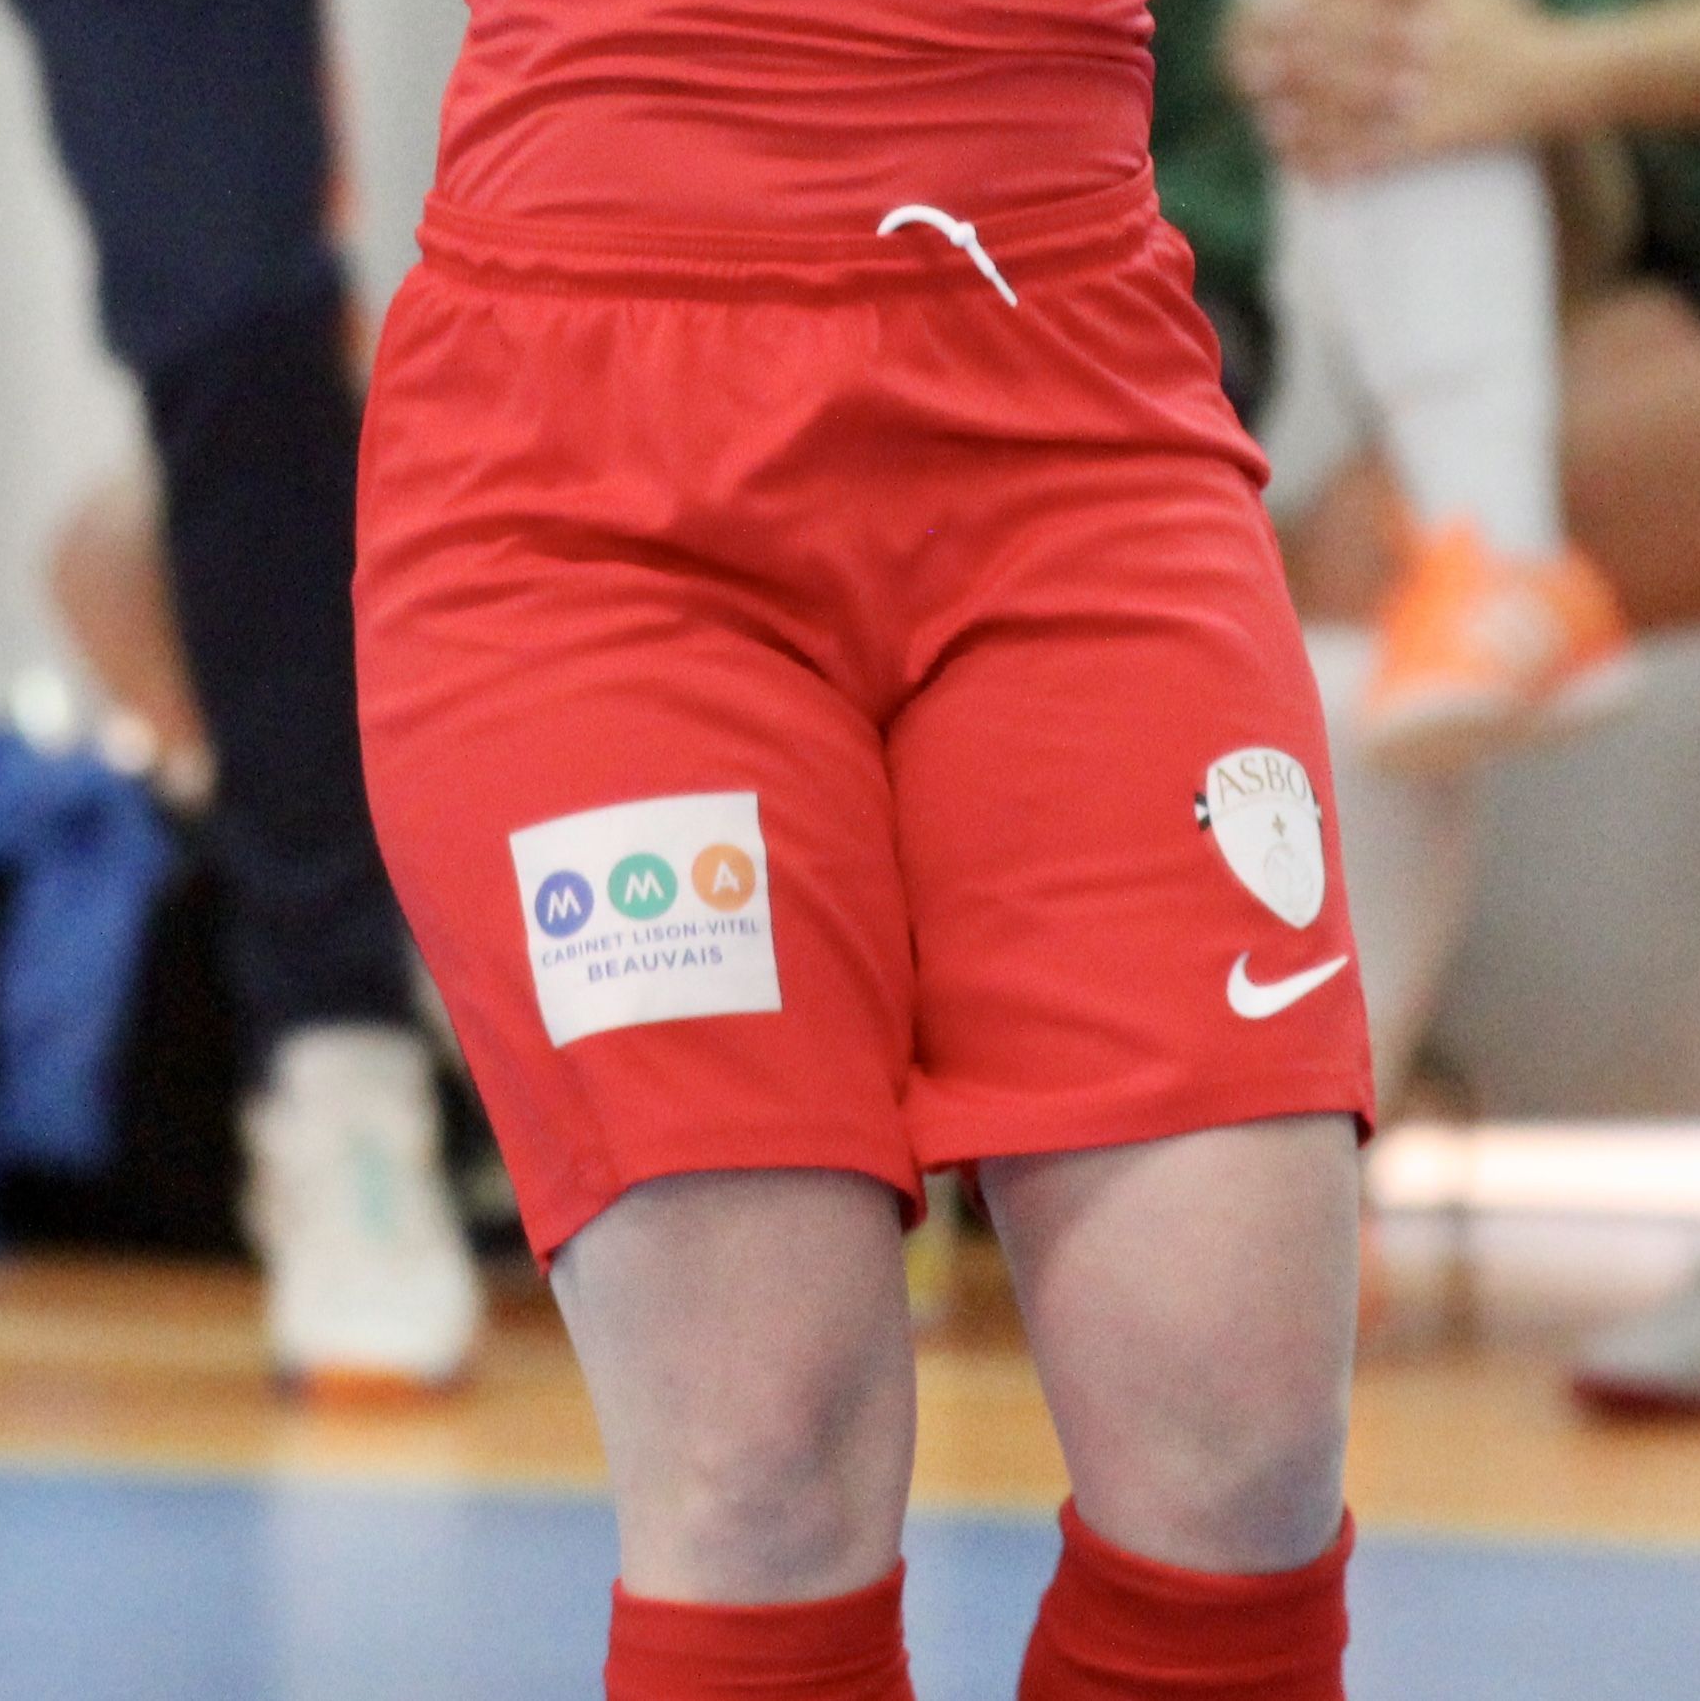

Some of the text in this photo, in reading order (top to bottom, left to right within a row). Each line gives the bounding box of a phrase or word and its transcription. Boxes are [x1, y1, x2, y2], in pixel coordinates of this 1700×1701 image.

[1215, 755, 1307, 805] ASBO
[542, 917, 761, 968] CABINET LISON-VITEL
[588, 944, 724, 983] BEAUVAIS
